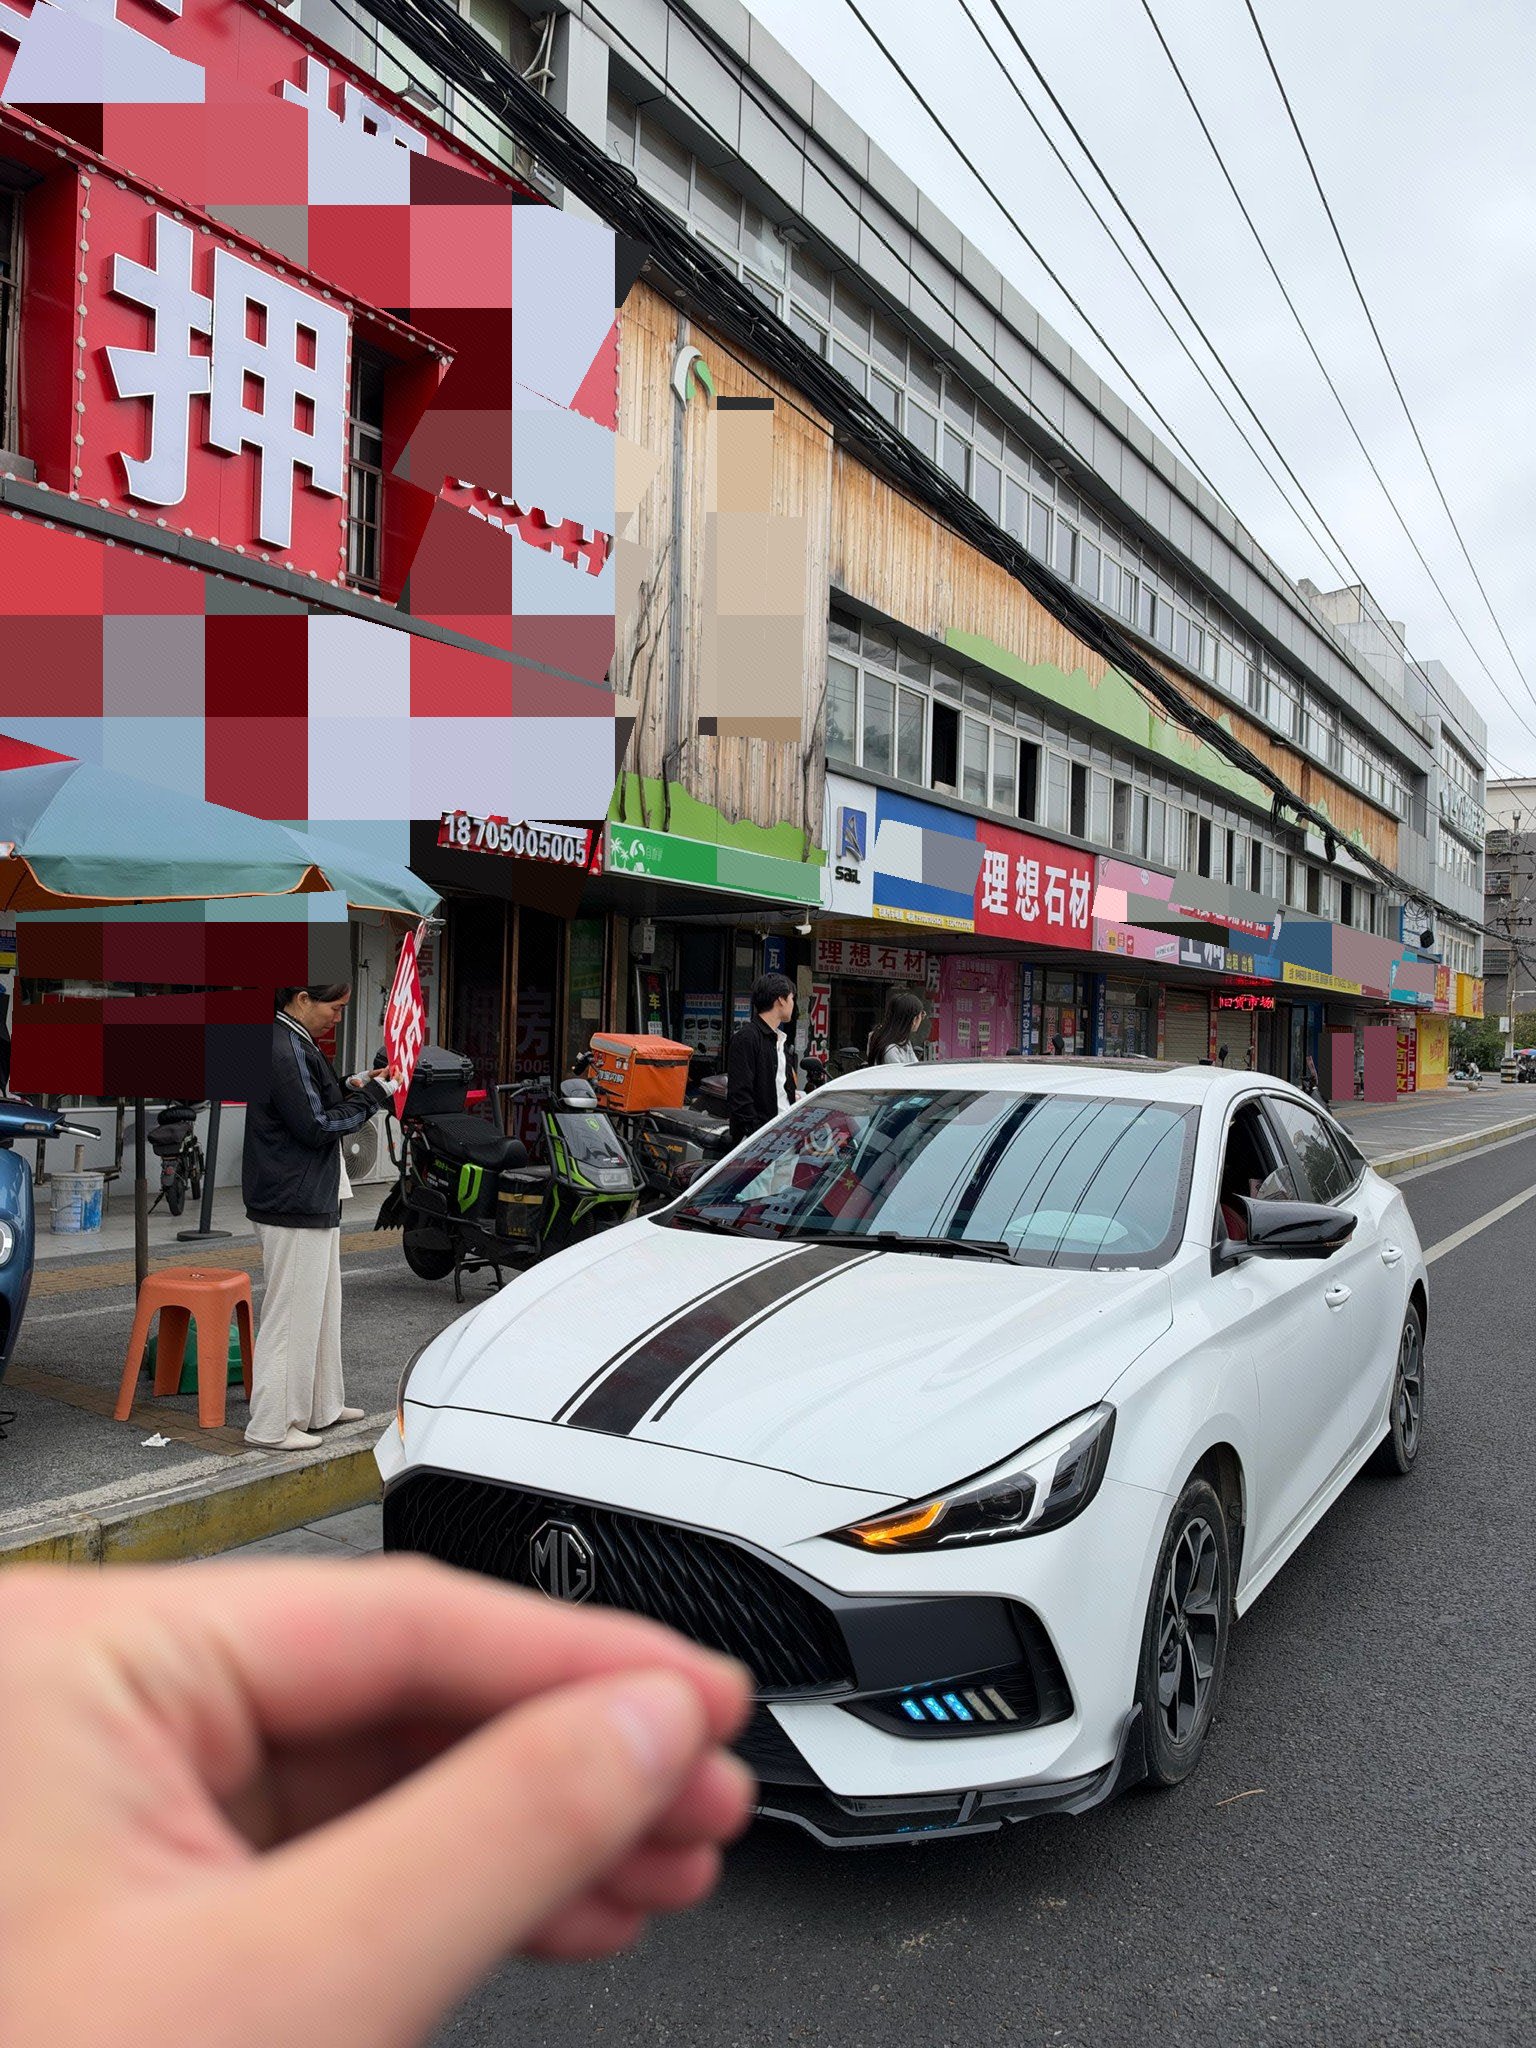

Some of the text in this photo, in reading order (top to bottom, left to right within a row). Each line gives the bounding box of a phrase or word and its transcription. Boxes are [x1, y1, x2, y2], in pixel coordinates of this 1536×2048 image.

[105, 212, 349, 550] 押
[445, 814, 587, 866] 18705005005
[982, 850, 1091, 930] 理想石材
[818, 940, 924, 972] 理想石材
[1219, 995, 1274, 1009] 旧货市场
[534, 1529, 587, 1599] MG
